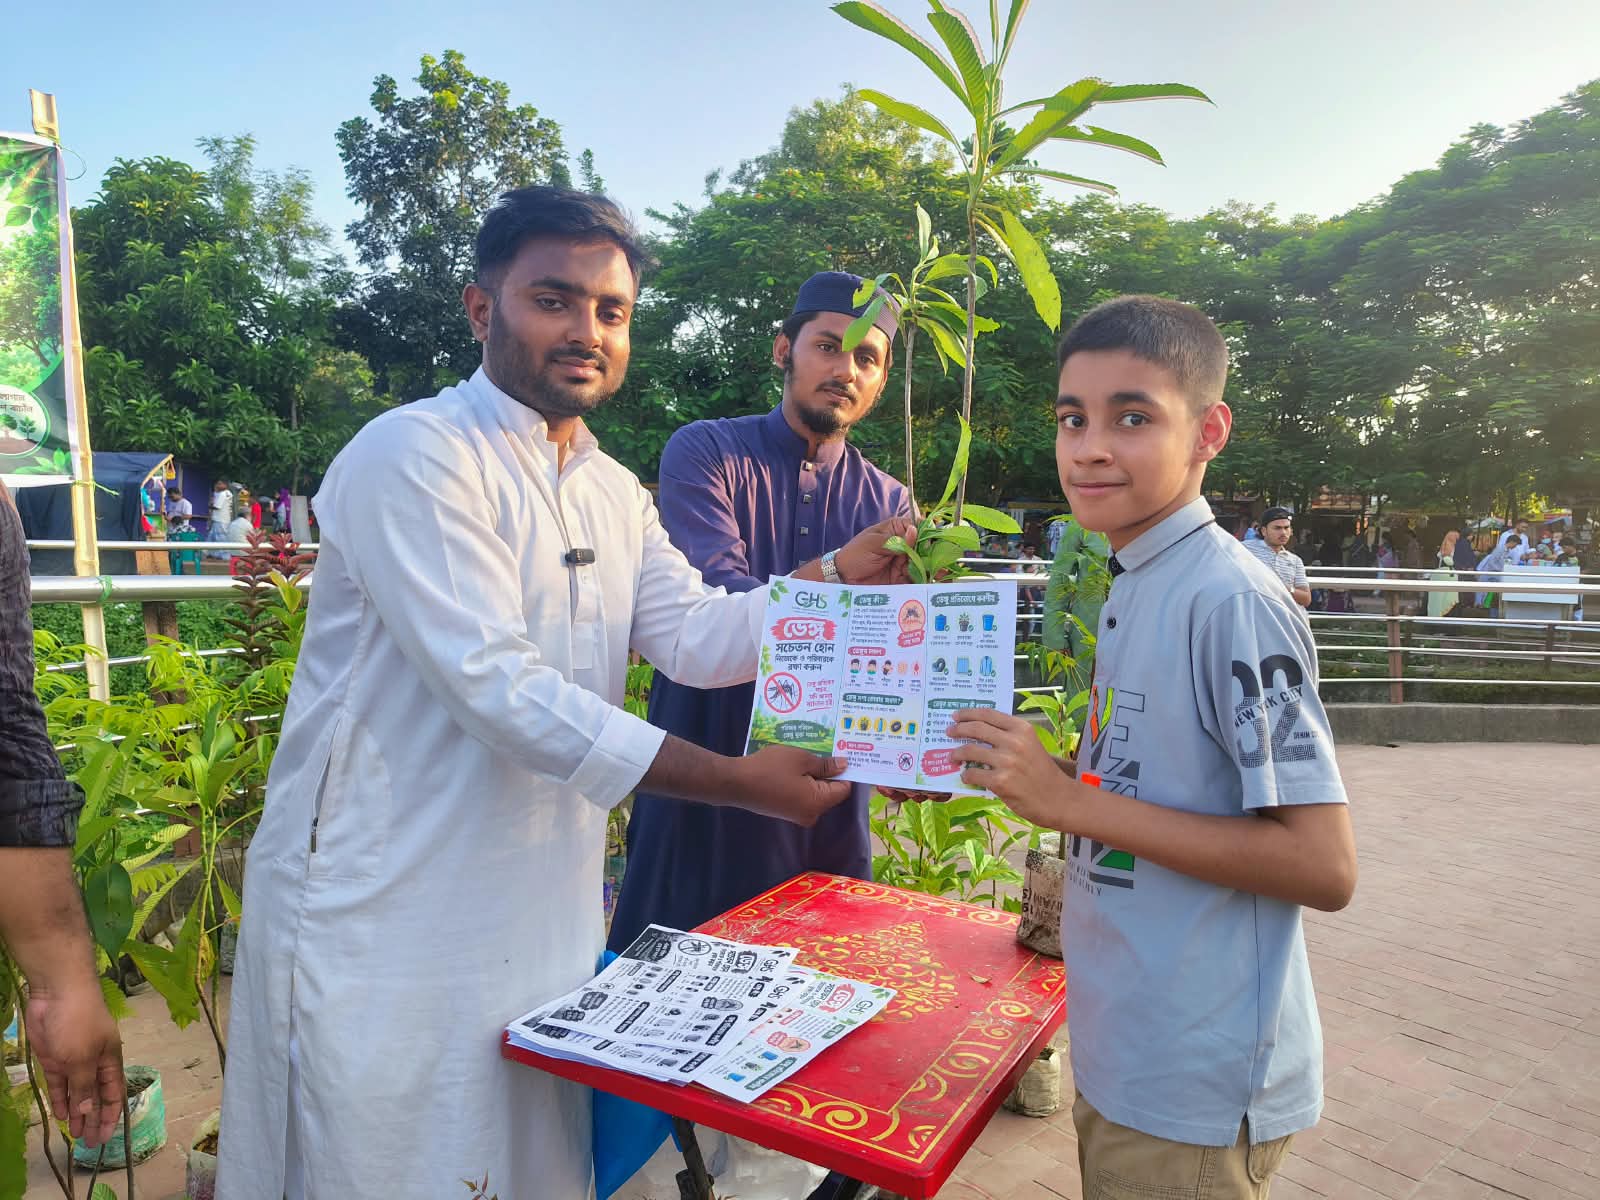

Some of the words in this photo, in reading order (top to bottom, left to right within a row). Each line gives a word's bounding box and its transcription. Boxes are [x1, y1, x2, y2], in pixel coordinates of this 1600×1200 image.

[795, 591, 829, 609] GHS
[784, 619, 826, 641] ডেঙ্গু
[776, 642, 812, 653] সচেতন
[815, 642, 835, 654] হোন
[775, 653, 799, 663] নিজেকে
[806, 653, 834, 663] পরিবারকে
[803, 663, 822, 671] করুন
